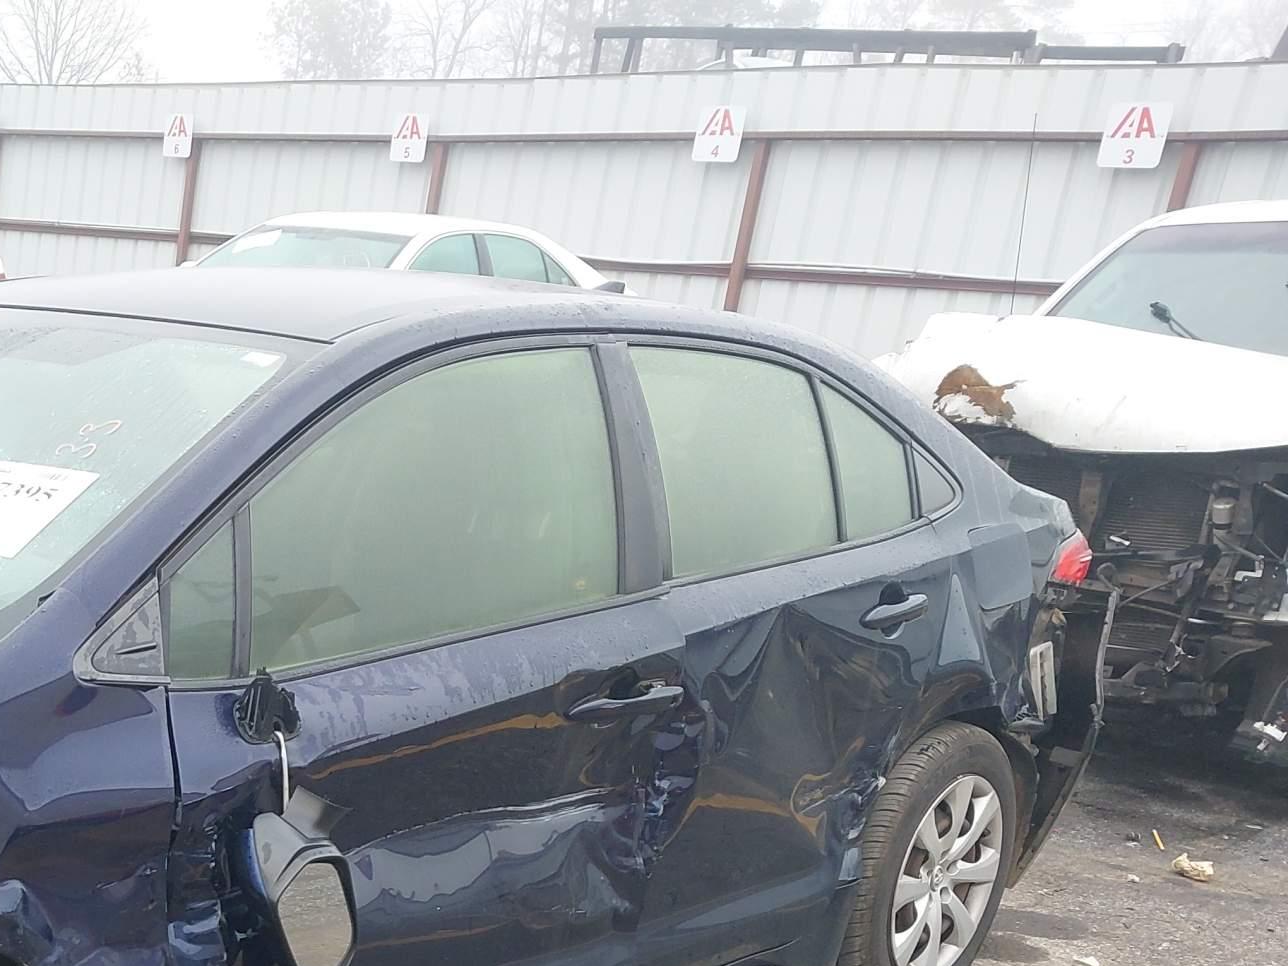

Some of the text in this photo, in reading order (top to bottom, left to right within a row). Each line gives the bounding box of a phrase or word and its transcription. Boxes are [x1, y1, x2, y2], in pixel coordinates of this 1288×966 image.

[173, 143, 180, 155] 6
[403, 146, 411, 159] 5
[710, 144, 721, 159] 4
[1122, 148, 1135, 166] 3
